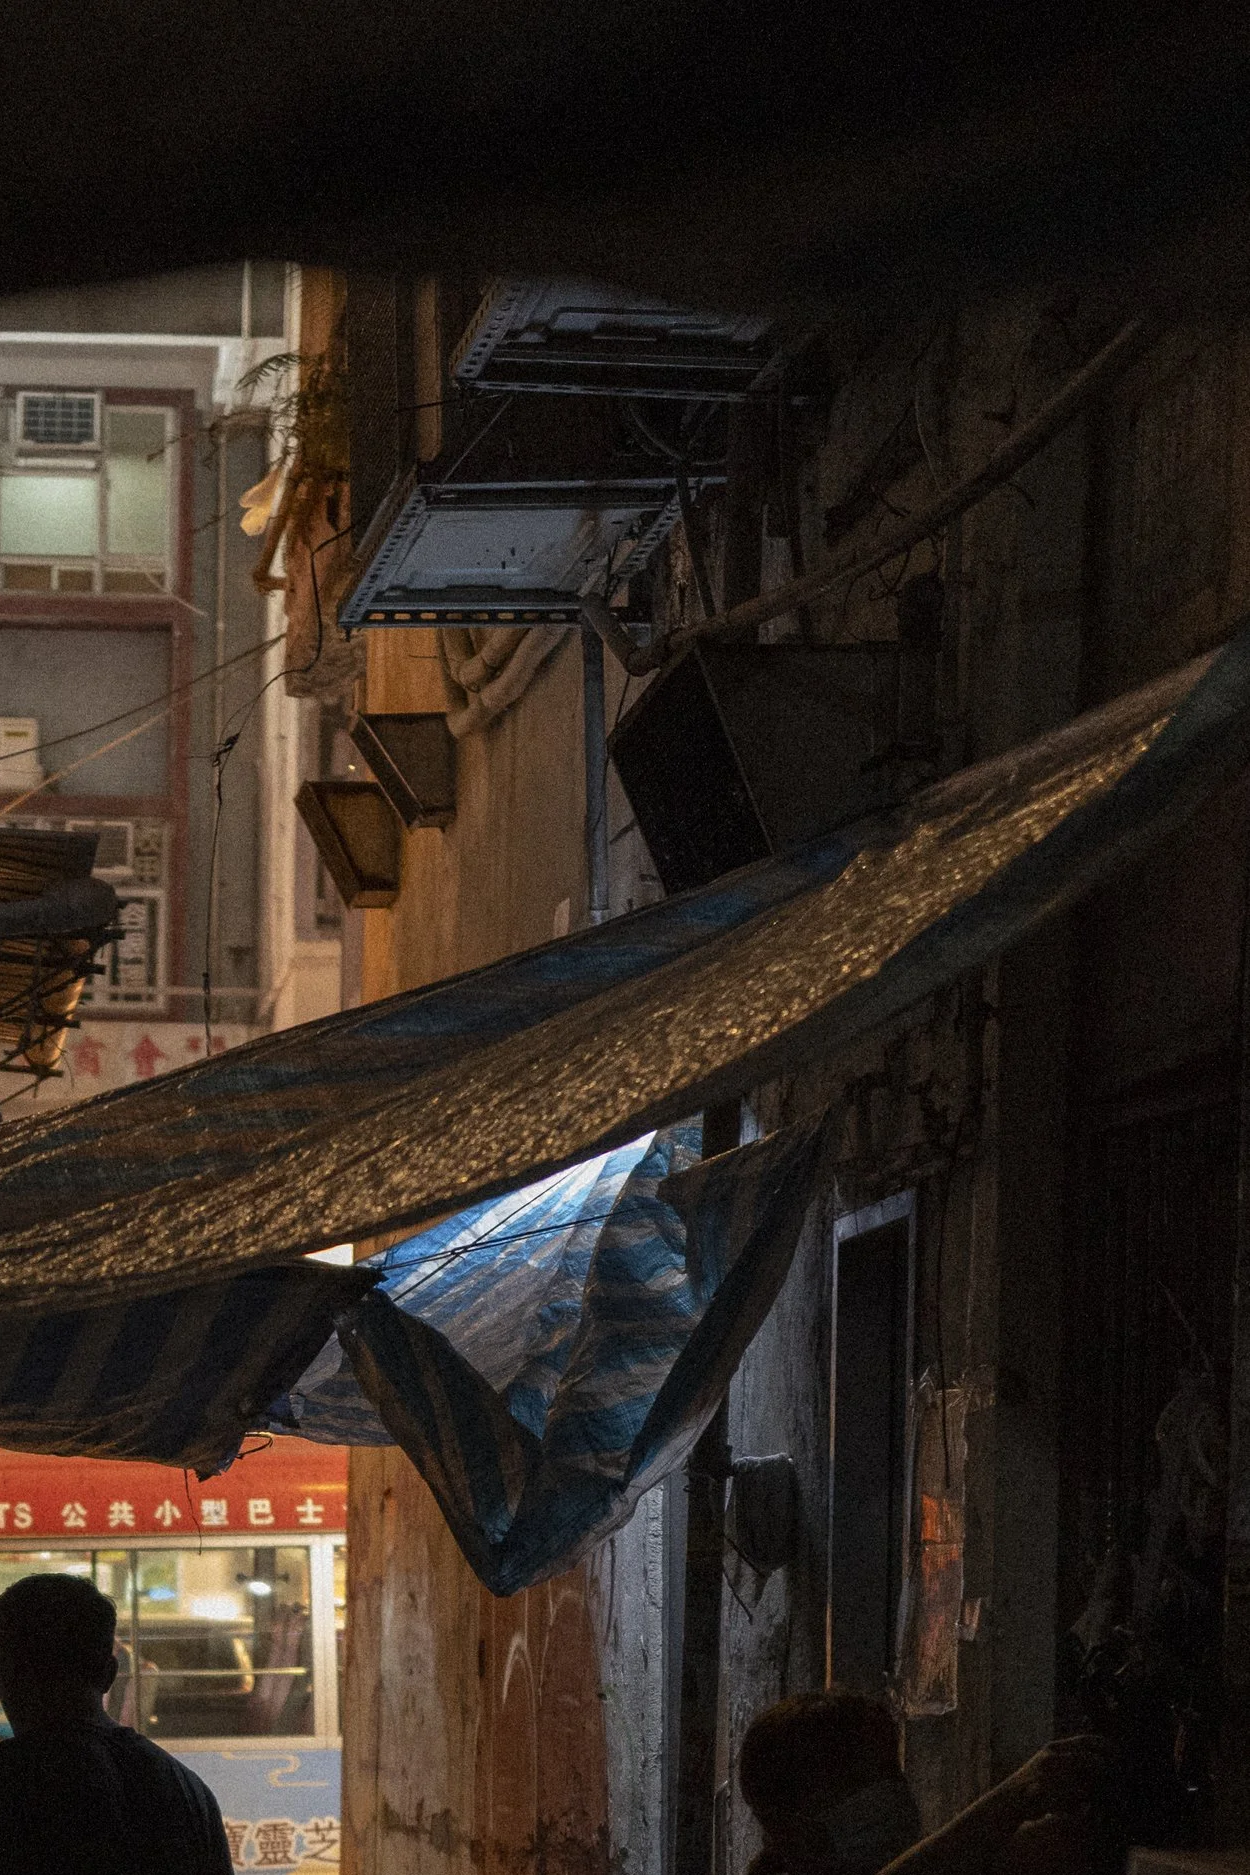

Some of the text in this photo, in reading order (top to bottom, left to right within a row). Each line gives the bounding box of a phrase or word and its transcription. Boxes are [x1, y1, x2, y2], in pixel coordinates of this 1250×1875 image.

[61, 1498, 325, 1529] 公共小型巴士
